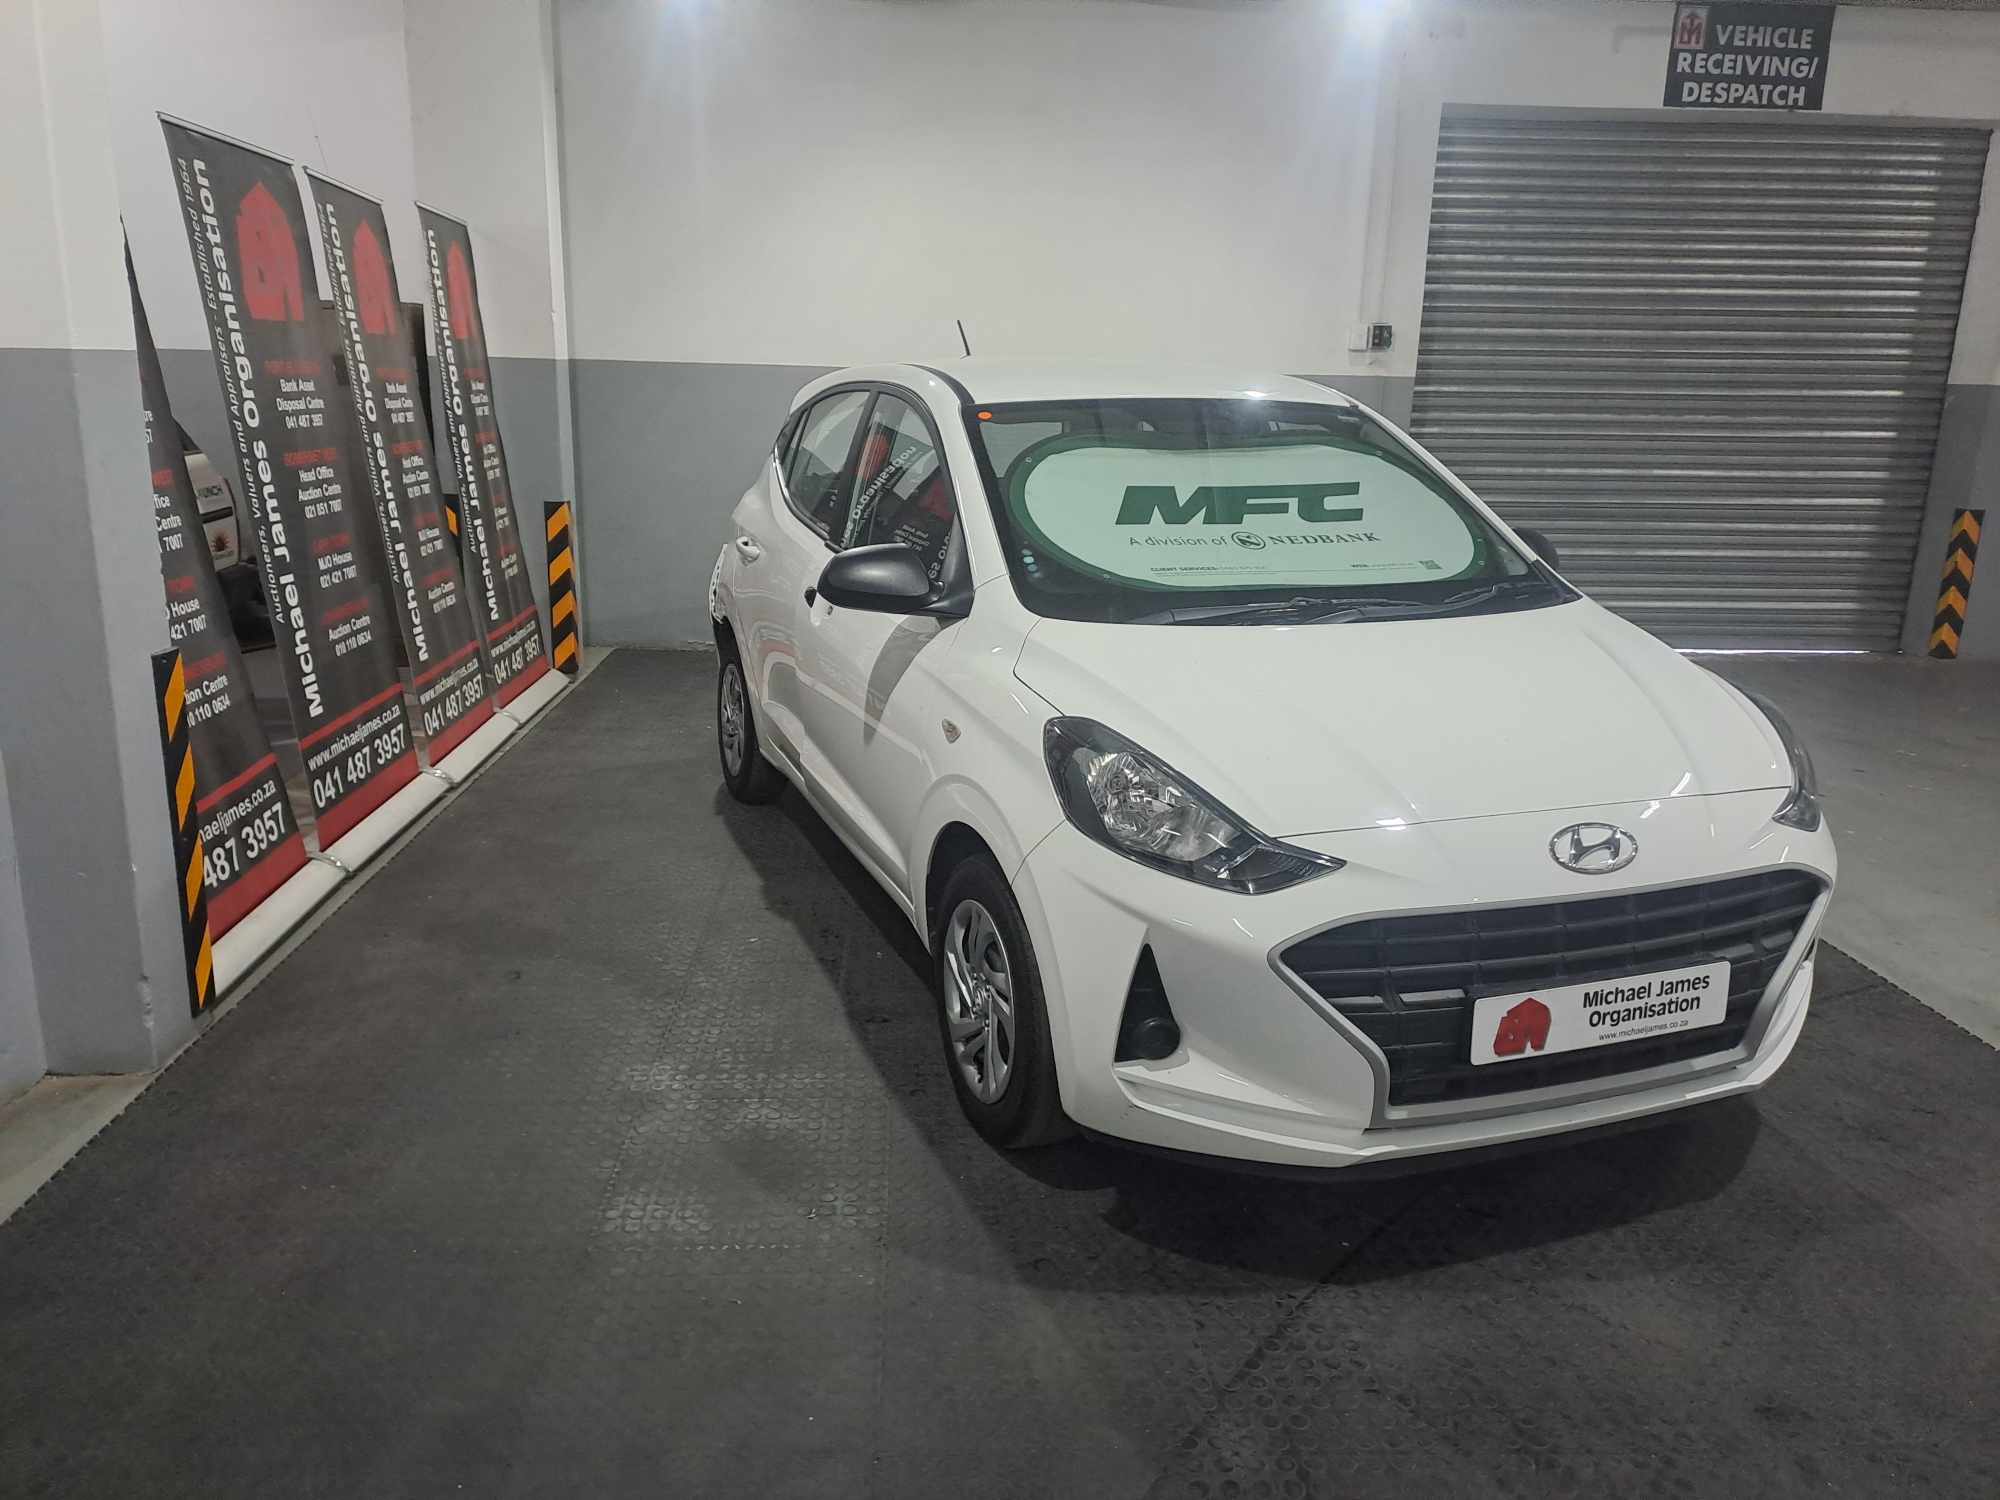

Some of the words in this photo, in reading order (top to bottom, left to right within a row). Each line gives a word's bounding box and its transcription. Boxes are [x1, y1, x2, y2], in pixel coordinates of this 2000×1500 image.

[1716, 24, 1815, 50] VEHICLE
[1676, 52, 1819, 79] RECEIVING/
[1681, 82, 1806, 106] DESPATCH
[177, 157, 194, 202] 1964
[189, 206, 217, 310] Established
[192, 158, 260, 428] Organisation
[326, 203, 377, 422] Organisation
[426, 229, 463, 416] Organisation
[214, 326, 240, 416] Appraisers
[280, 378, 298, 392] Bank
[276, 397, 306, 413] Disposal
[233, 420, 248, 453] and
[372, 431, 402, 534] James
[459, 423, 480, 512] James
[243, 457, 261, 519] Valuers
[253, 439, 290, 563] James
[298, 488, 323, 502] Auction
[1115, 481, 1364, 525] MFC
[154, 514, 182, 531] Centre
[1129, 536, 1142, 546] A
[1145, 535, 1208, 546] division
[1212, 535, 1228, 546] of
[1268, 532, 1382, 545] NEDBANK
[163, 533, 184, 552] 7007
[333, 552, 353, 566] House
[259, 525, 284, 624] Auctioneers,
[473, 518, 499, 621] Michael
[170, 598, 200, 618] House
[395, 542, 429, 662] Michael
[170, 623, 188, 641] 421
[188, 613, 207, 634] 7007
[279, 573, 324, 718] Michael
[328, 624, 352, 641] Auction
[202, 673, 229, 696] Centre
[494, 658, 511, 684] 041
[195, 704, 211, 722] 110
[212, 693, 231, 715] 0634
[424, 703, 445, 736] 041
[445, 689, 462, 720] 487
[462, 673, 483, 707] 3957
[307, 704, 401, 772] www.michaeljames.co.za
[313, 765, 344, 809] 041
[346, 745, 371, 783] 487
[374, 723, 405, 765] 3957
[203, 837, 240, 889] 487
[241, 801, 286, 860] 3957
[1582, 982, 1652, 1009] Michael
[1655, 974, 1711, 998] James
[1588, 995, 1701, 1027] Organisation
